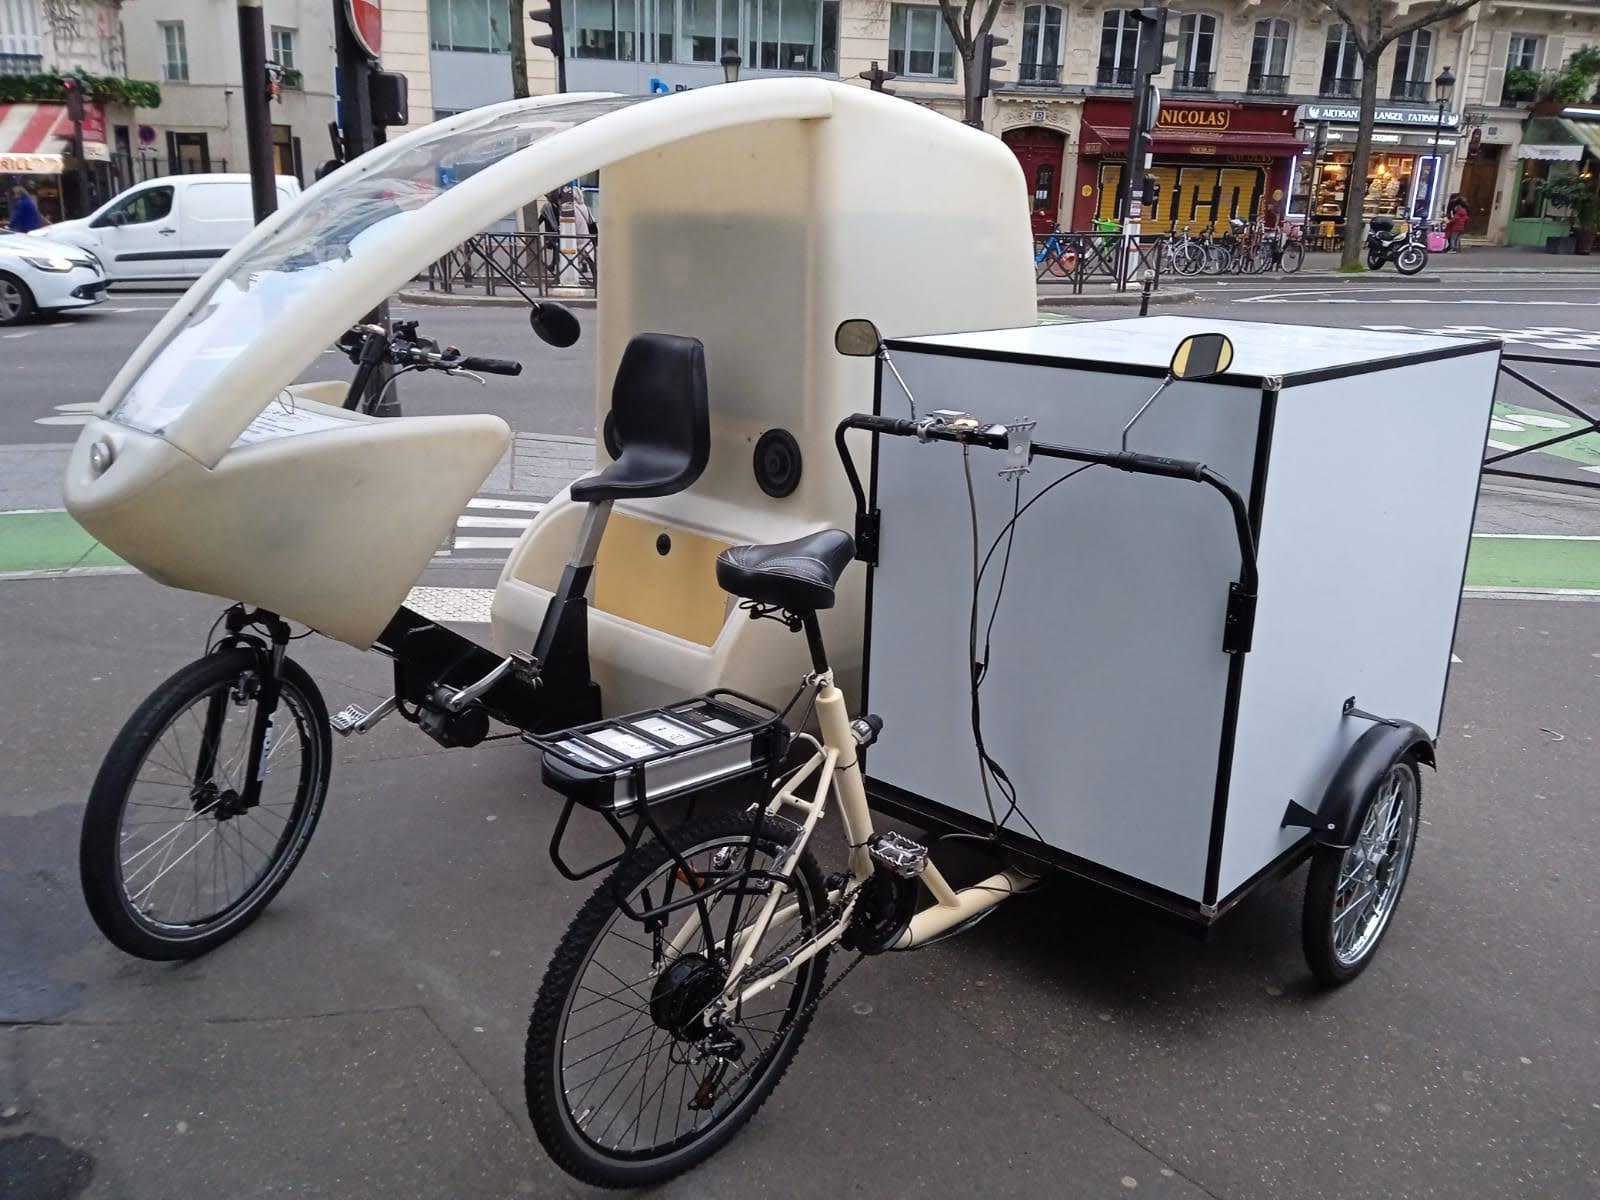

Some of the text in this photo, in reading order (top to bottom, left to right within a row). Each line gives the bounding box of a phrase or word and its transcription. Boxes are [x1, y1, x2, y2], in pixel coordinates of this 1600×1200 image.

[1160, 109, 1226, 125] NICOLAS
[1322, 109, 1359, 118] ARTISAN
[1374, 111, 1404, 122] LANGER
